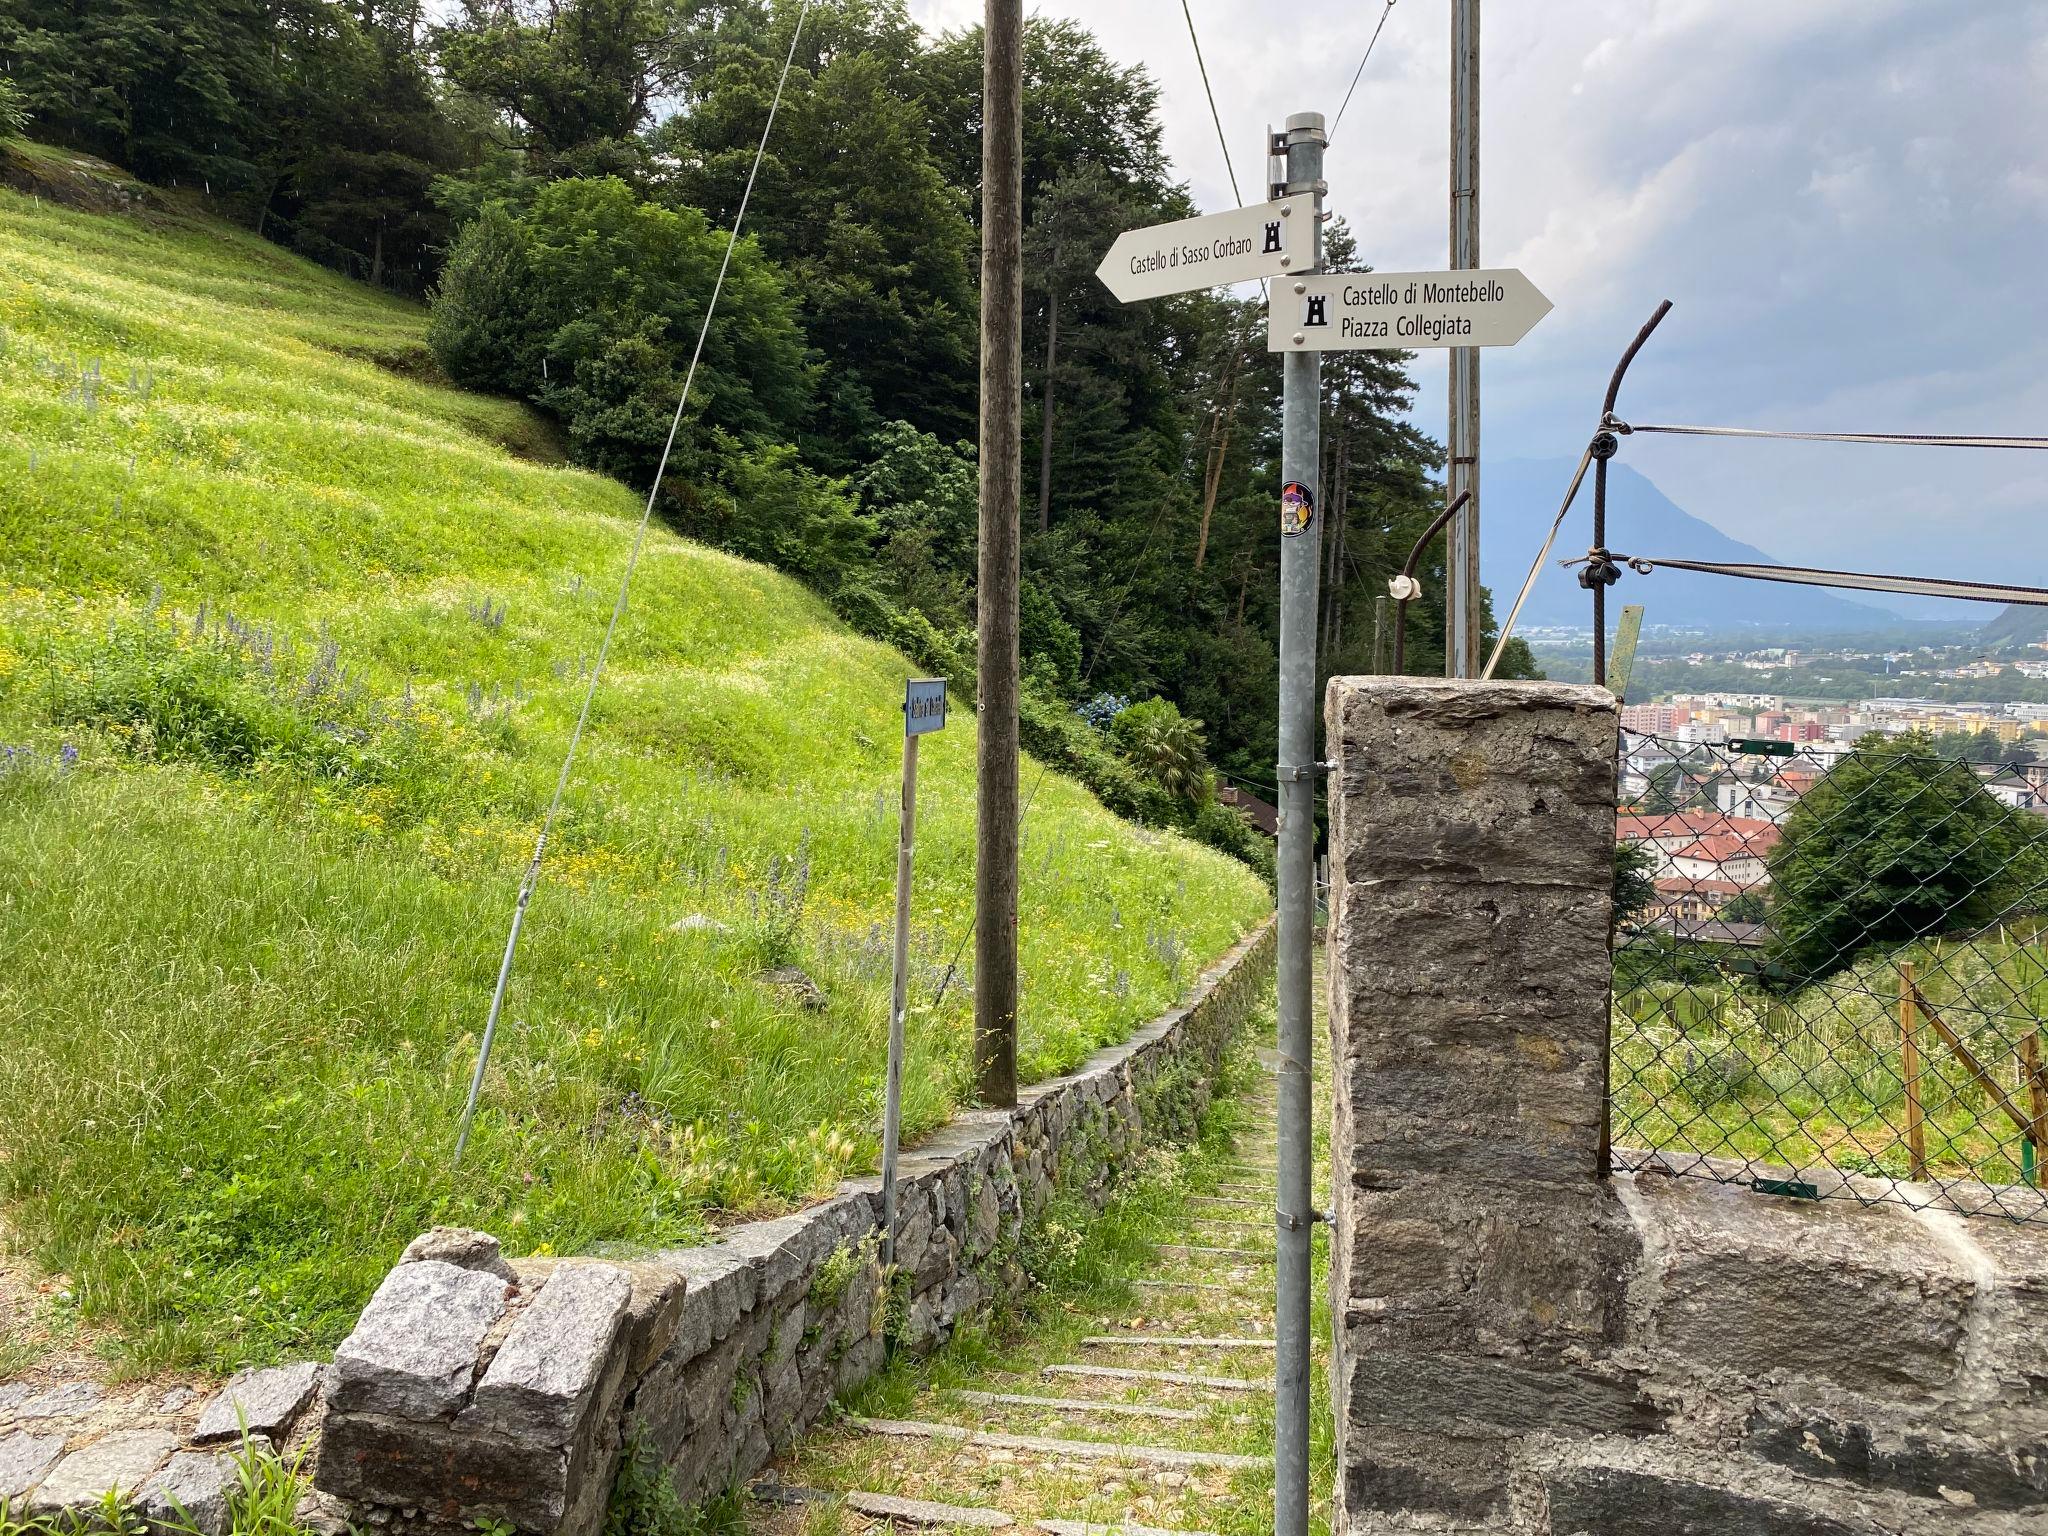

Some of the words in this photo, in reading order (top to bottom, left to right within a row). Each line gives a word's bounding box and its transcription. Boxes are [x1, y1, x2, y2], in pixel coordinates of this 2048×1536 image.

[1131, 250, 1166, 275] Castello
[1169, 247, 1178, 267] di
[1182, 246, 1209, 265] Sasso
[1213, 236, 1252, 259] Corbaro
[1343, 284, 1397, 306] Castello
[1404, 282, 1417, 304] di
[1423, 279, 1504, 304] Montebello
[1341, 317, 1388, 337] Piazza
[1396, 314, 1471, 341] Collegiata
